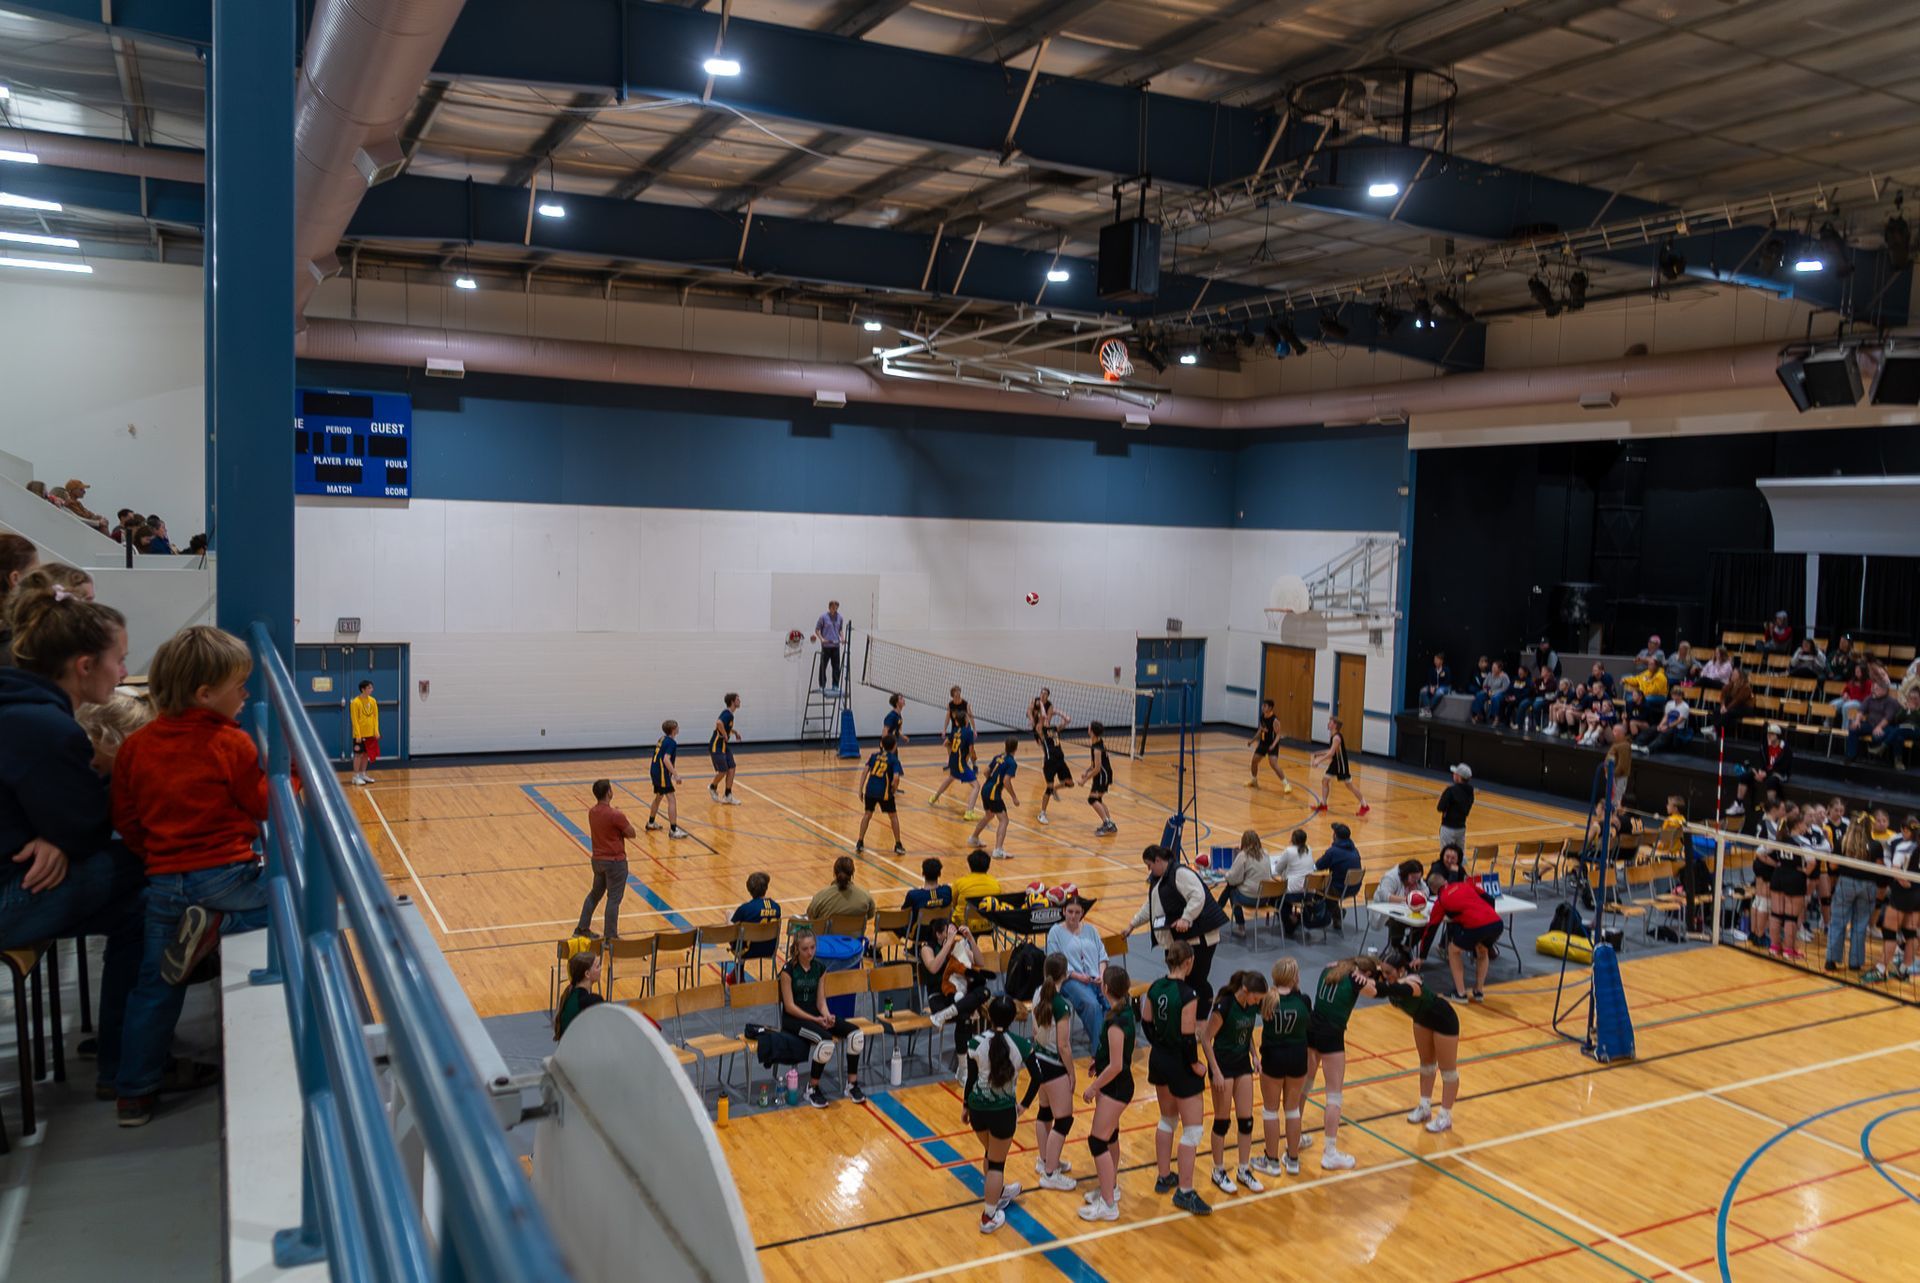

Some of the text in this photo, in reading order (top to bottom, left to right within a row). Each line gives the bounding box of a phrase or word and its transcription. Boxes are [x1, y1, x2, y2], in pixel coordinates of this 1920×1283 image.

[325, 425, 352, 434] PERIOD
[371, 423, 405, 434] GUEST
[313, 456, 364, 467] PLAYER FOUL
[385, 460, 408, 469] FOULS
[326, 485, 352, 494] MATCH
[385, 488, 408, 496] SCORE
[341, 620, 357, 632] EXIT
[872, 760, 888, 777] 12
[1157, 993, 1168, 1021] 2
[1273, 1008, 1298, 1034] 17
